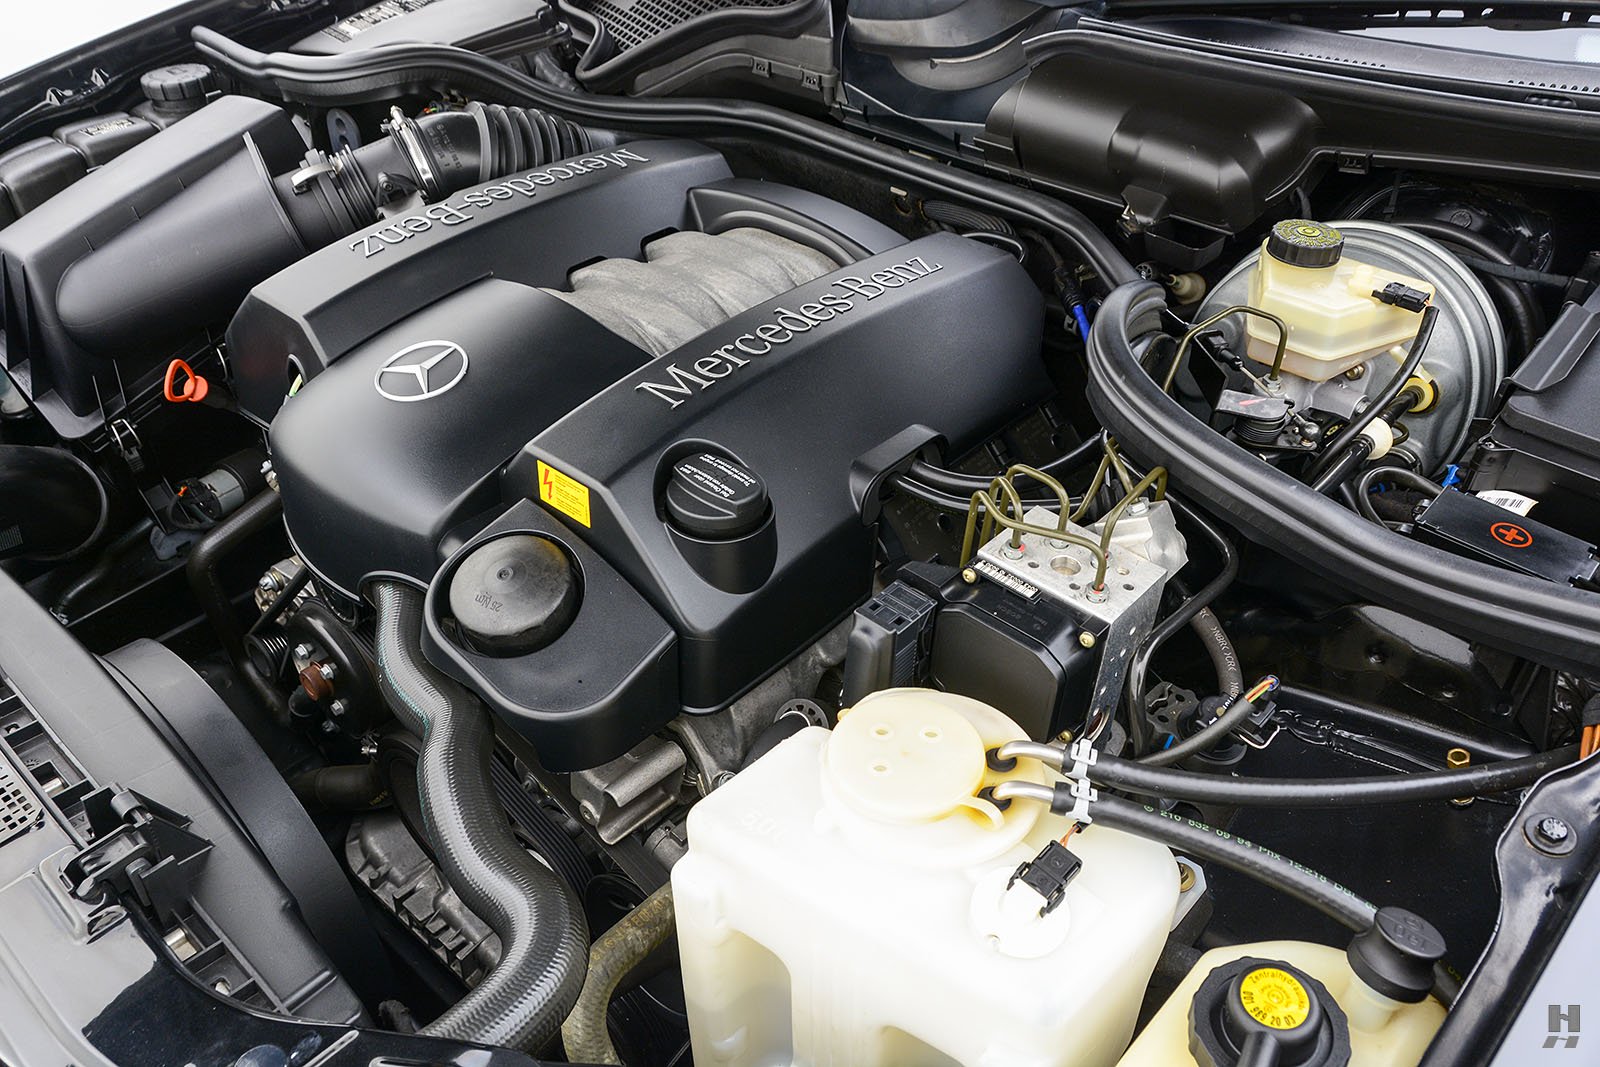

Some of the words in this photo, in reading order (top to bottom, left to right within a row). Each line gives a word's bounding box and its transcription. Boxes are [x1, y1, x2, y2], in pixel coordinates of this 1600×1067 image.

[349, 149, 650, 257] Mercedes-Benz
[635, 256, 943, 409] Mercedes-Benz
[490, 601, 503, 612] 25
[1160, 809, 1182, 821] 210
